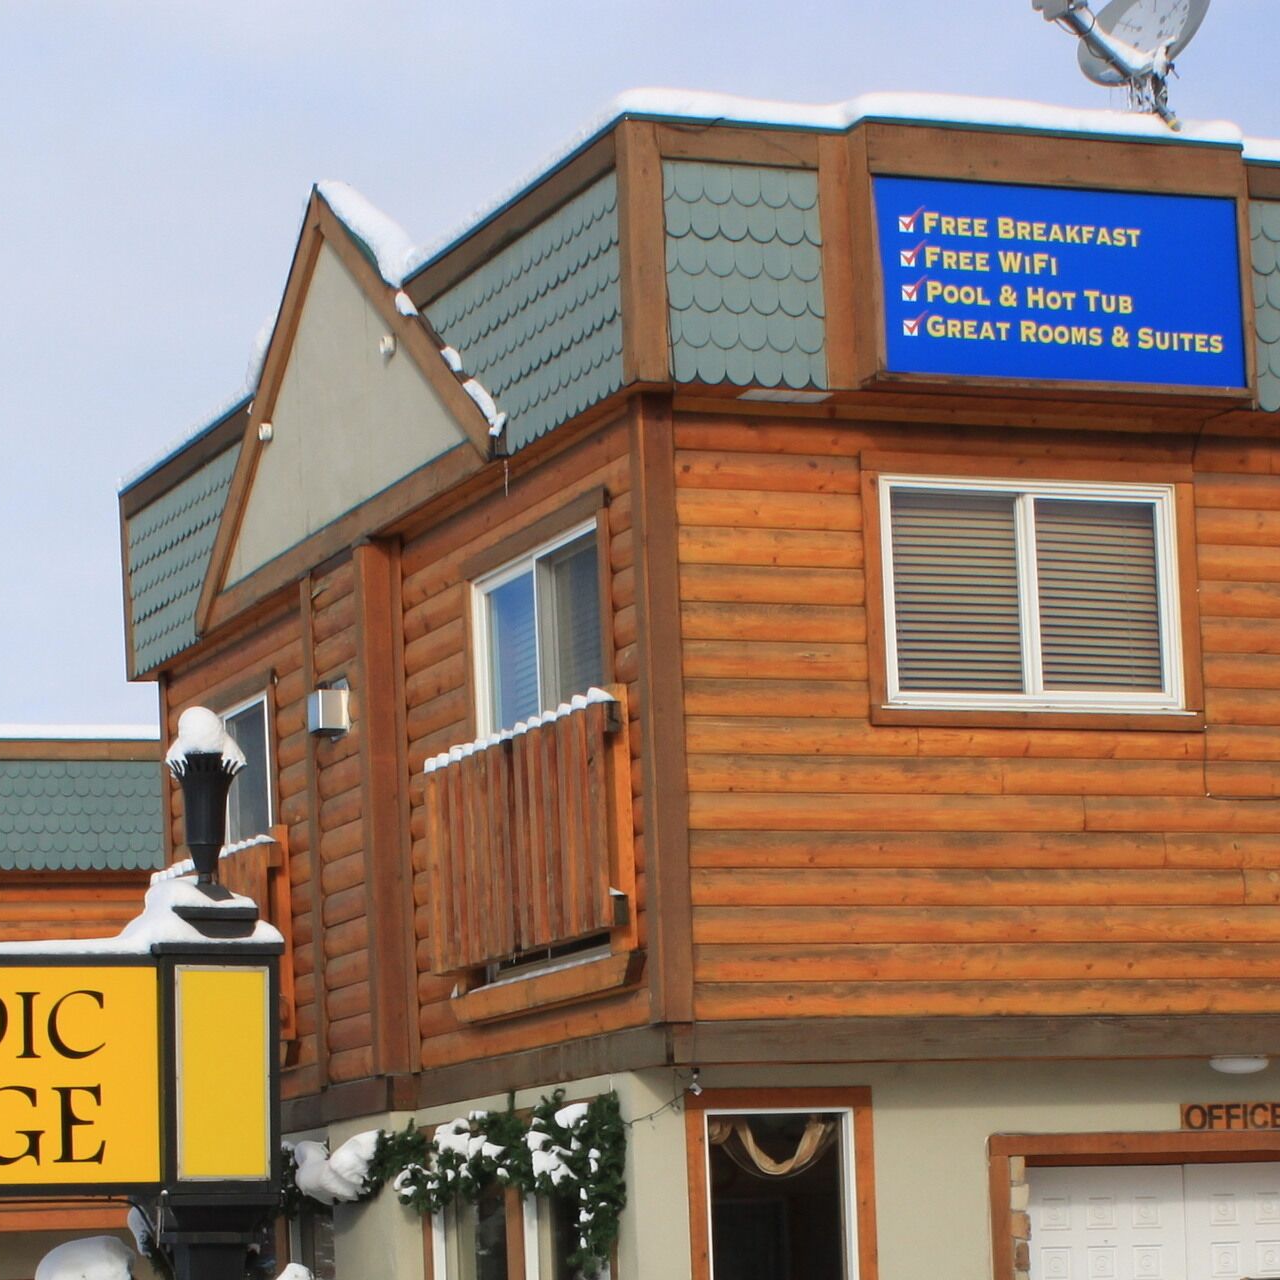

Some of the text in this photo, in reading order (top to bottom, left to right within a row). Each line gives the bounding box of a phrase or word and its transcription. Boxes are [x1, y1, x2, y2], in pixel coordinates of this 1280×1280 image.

[923, 212, 1141, 247] FREE BREAKFAST
[924, 246, 990, 272] FREE
[926, 280, 1133, 314] POOL & HOT TUB
[926, 315, 1223, 353] GREAT ROOMS & SUITES
